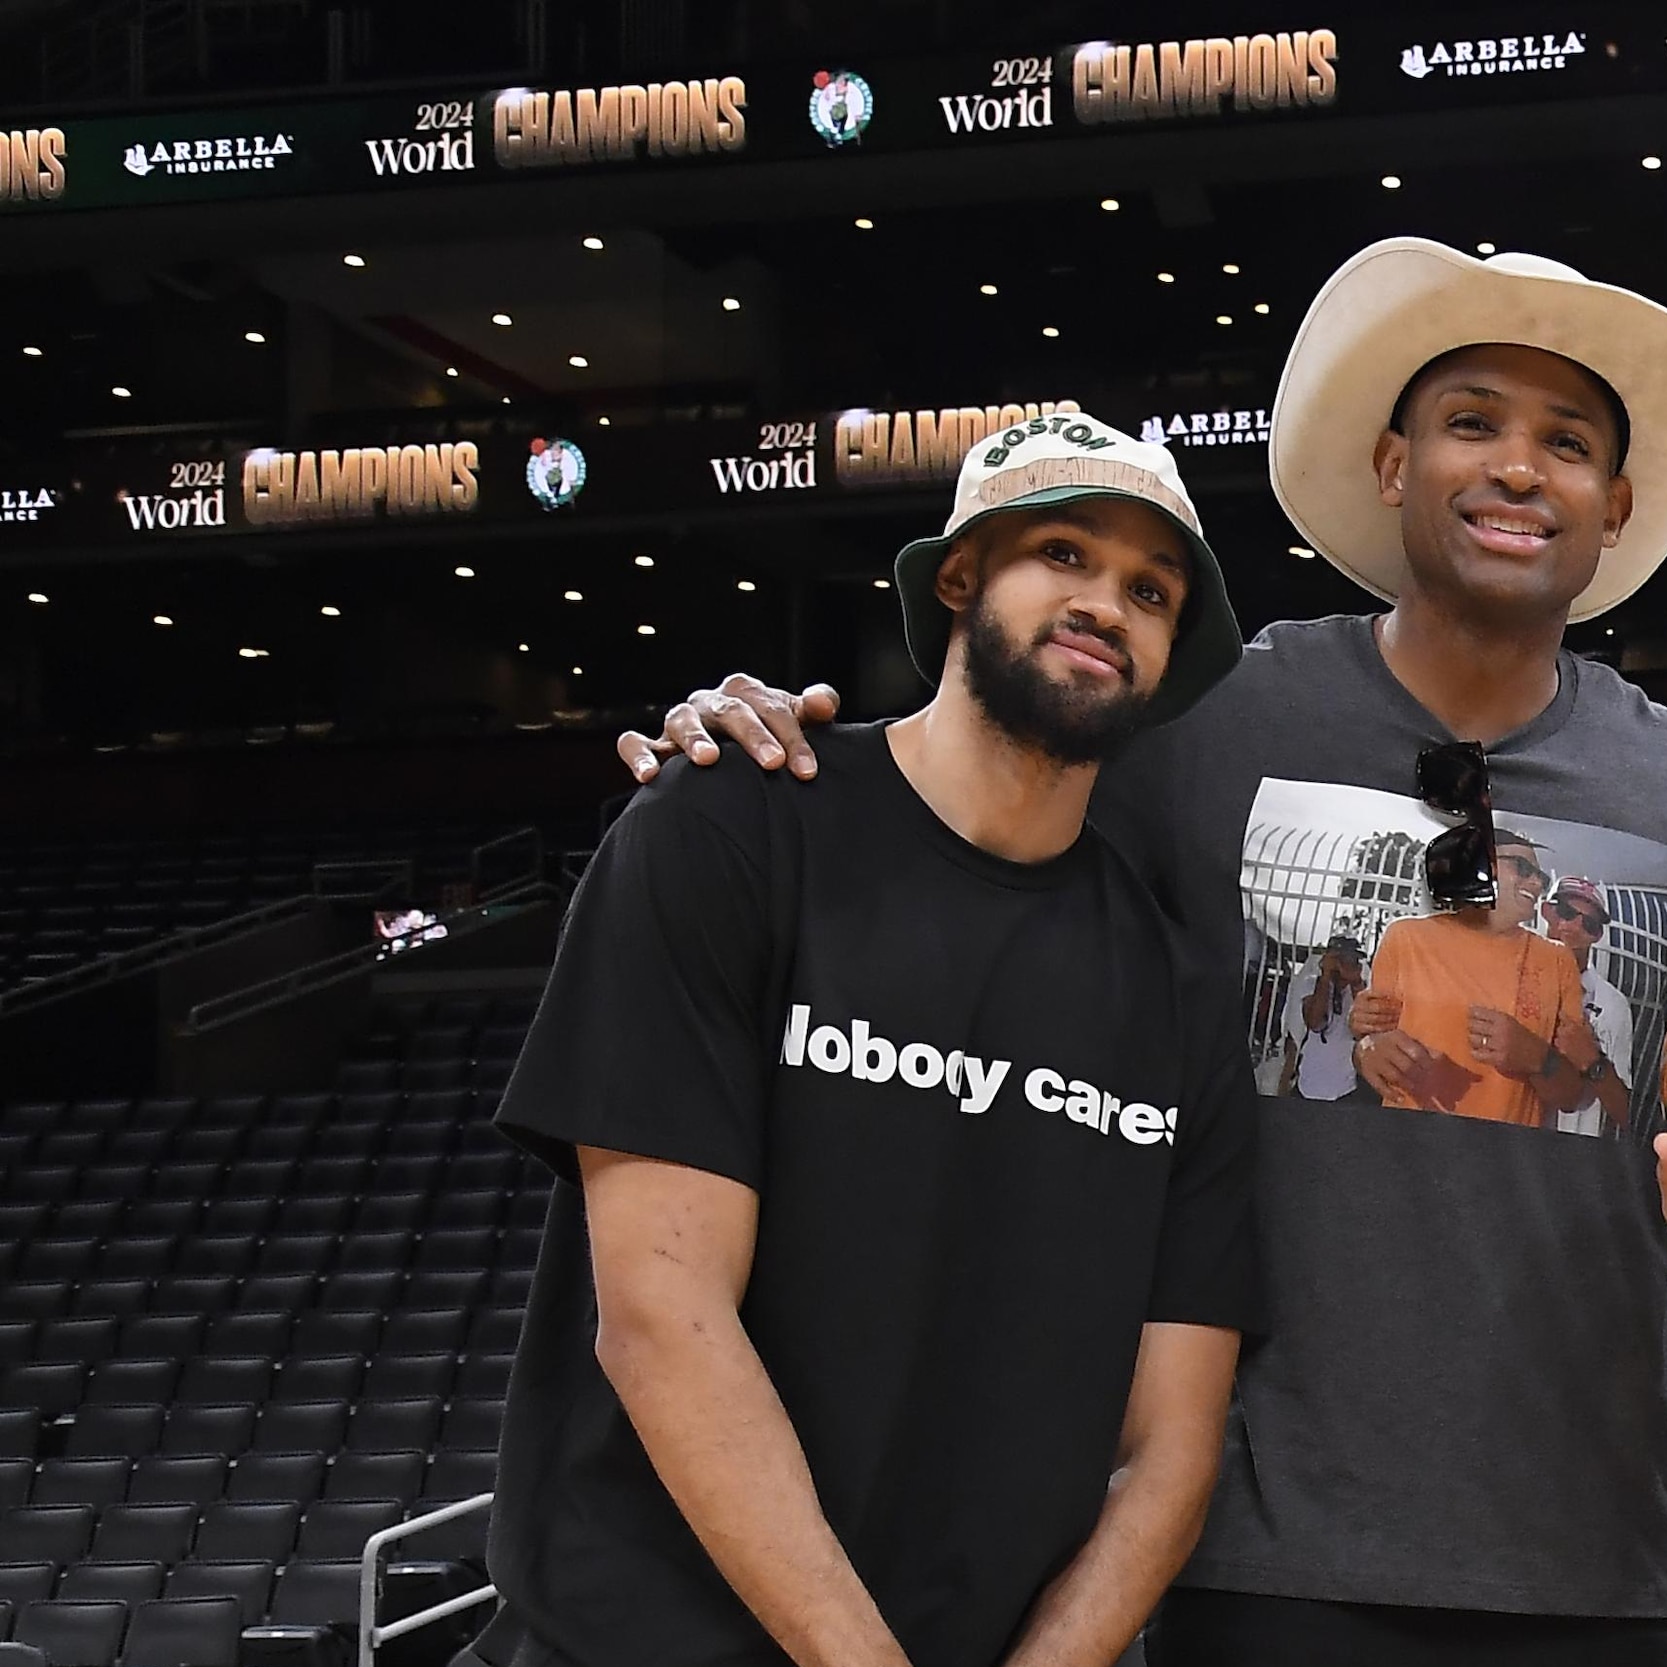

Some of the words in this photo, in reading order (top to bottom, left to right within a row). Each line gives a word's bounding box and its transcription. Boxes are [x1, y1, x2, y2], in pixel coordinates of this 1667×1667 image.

[1430, 34, 1584, 65] ARBELLA
[993, 57, 1053, 88] 2024
[1071, 29, 1339, 127] CHAMPIONS
[1446, 56, 1567, 77] INSURANCE
[416, 102, 475, 132] 2024
[493, 76, 748, 169] CHAMPIONS
[940, 88, 1053, 134] World
[151, 134, 292, 162] ARBELLA
[366, 132, 475, 176] World
[166, 154, 276, 174] INSURANCE
[759, 422, 816, 450] 2024
[1167, 409, 1272, 435] ARBEL
[984, 415, 1117, 468] BOSTON
[171, 460, 226, 488] 2024
[243, 441, 480, 525] CHAMPIONS
[712, 449, 816, 494] World
[124, 488, 226, 531] World
